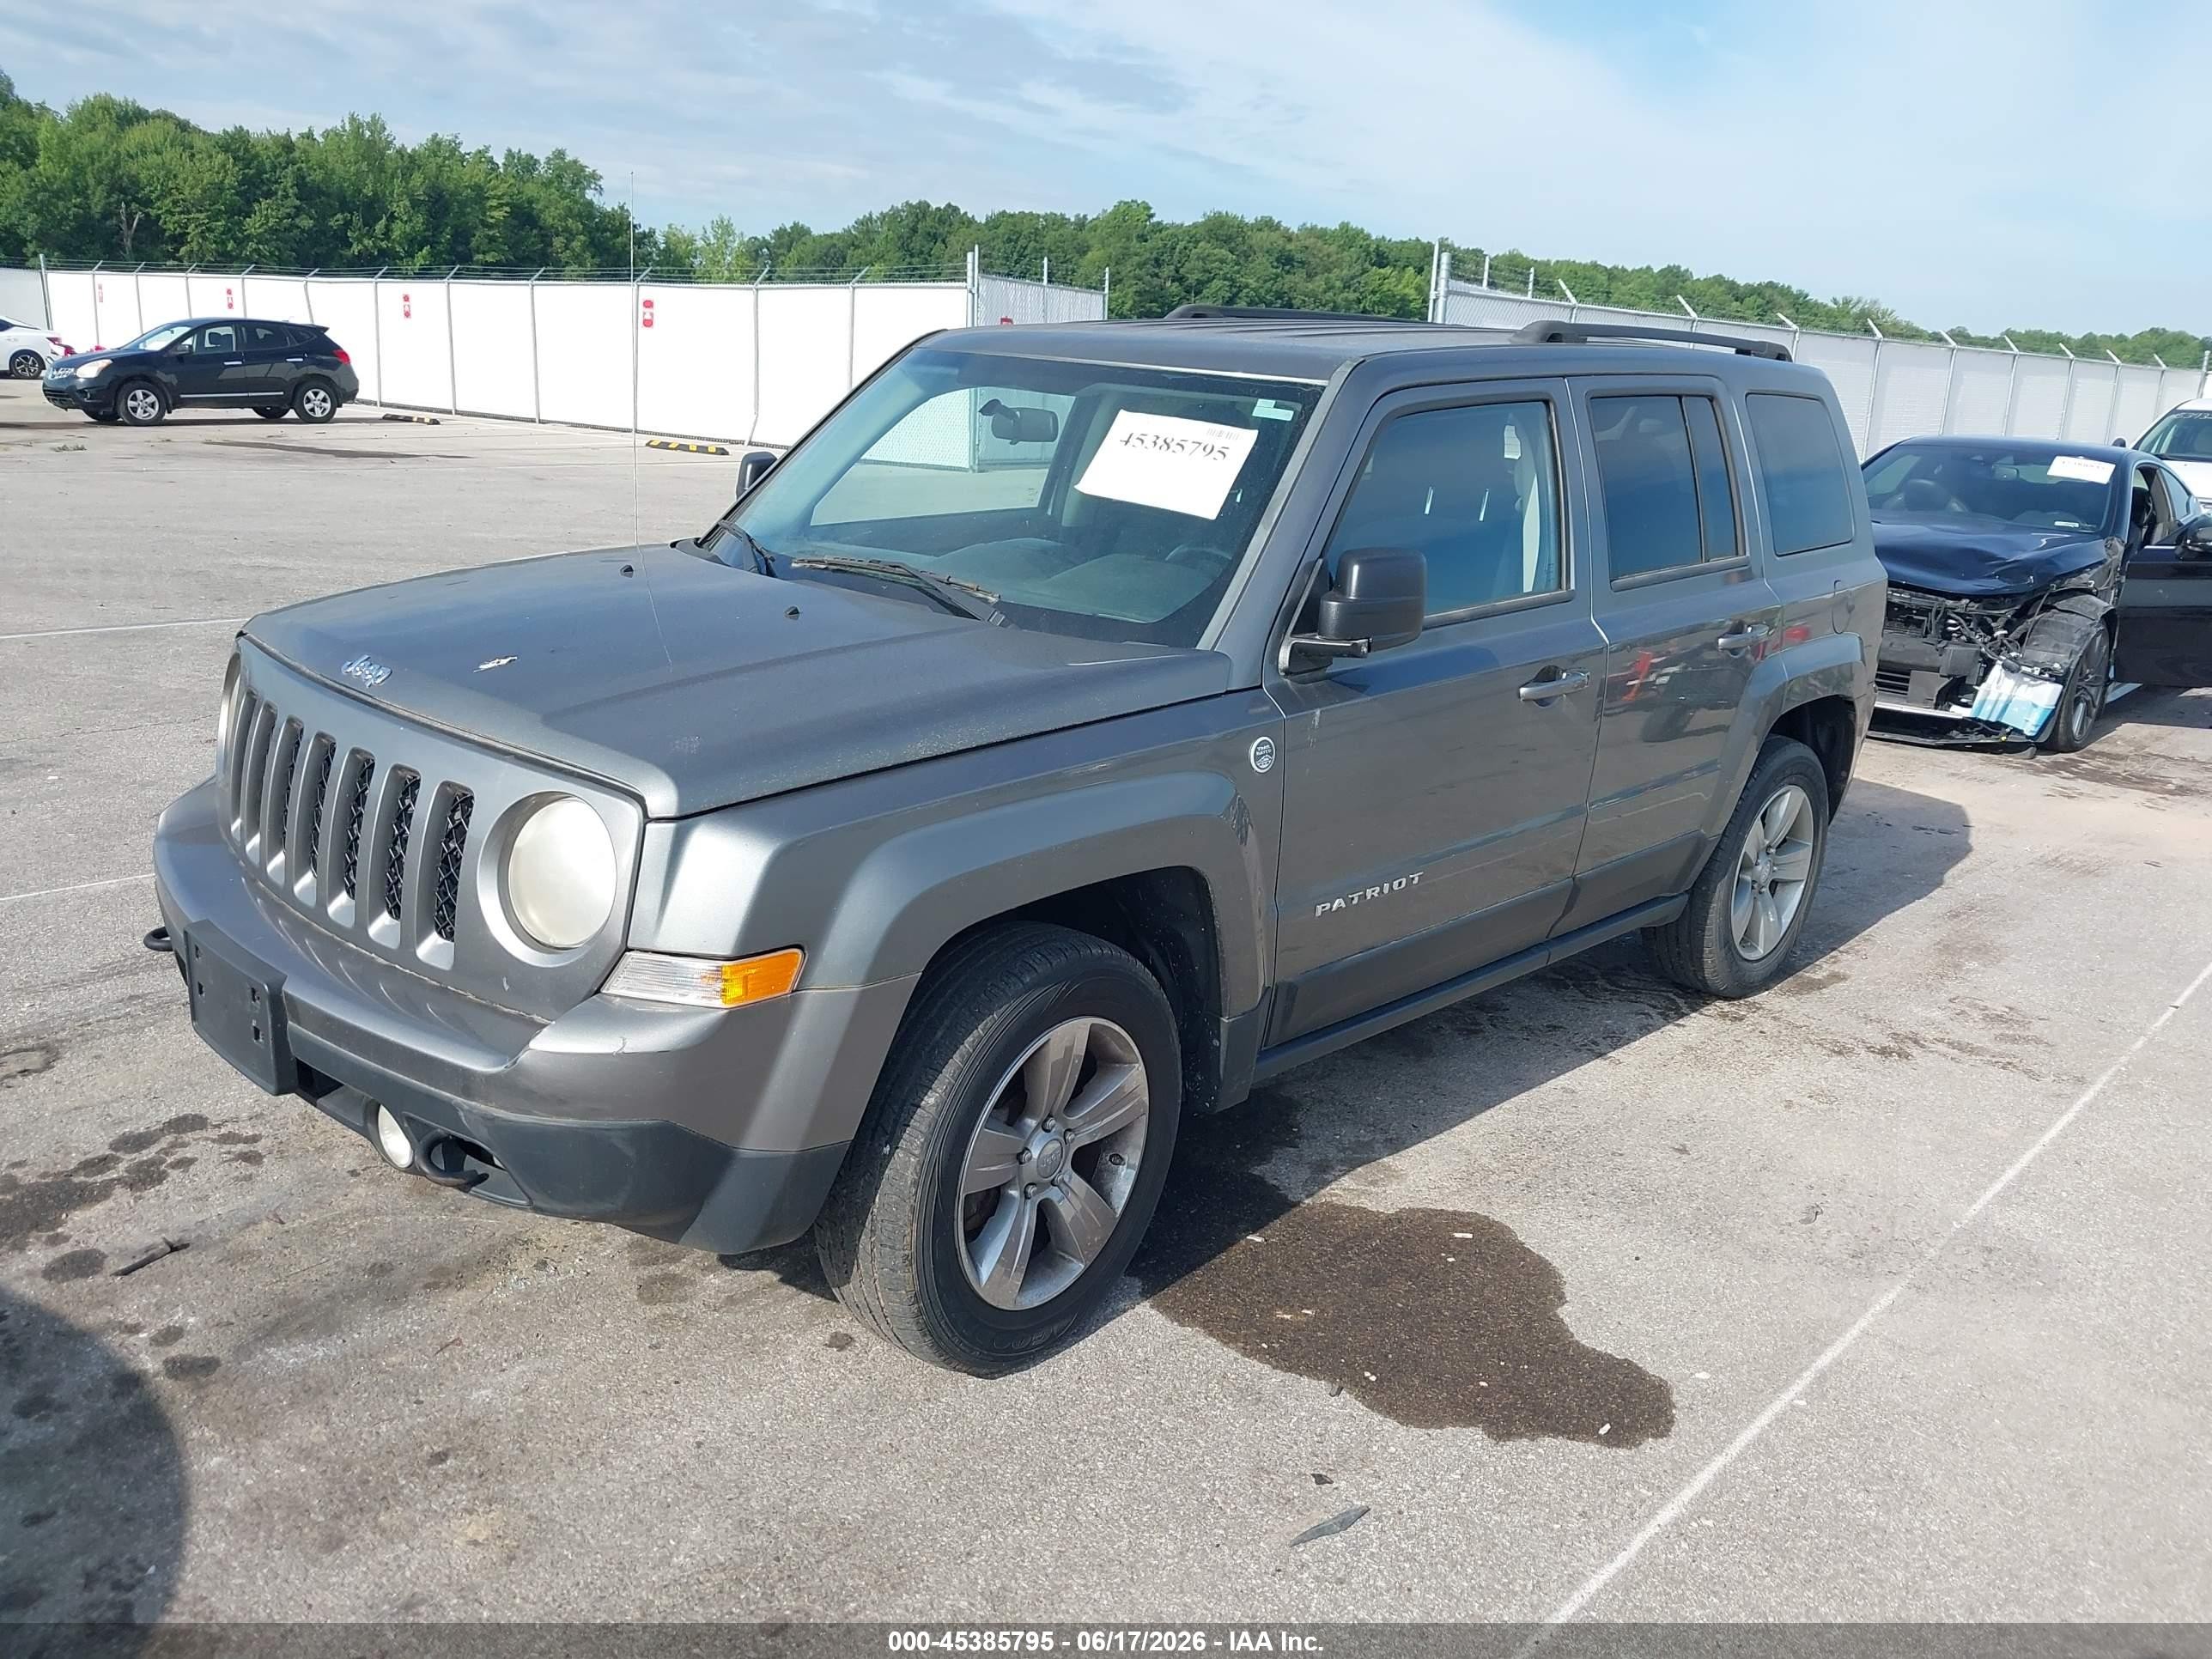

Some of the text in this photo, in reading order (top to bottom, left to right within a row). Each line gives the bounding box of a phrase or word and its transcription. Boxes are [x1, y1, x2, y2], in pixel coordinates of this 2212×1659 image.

[1120, 432, 1230, 461] 45385795
[342, 654, 392, 688] Jeep
[1315, 872, 1424, 917] PATRIOT
